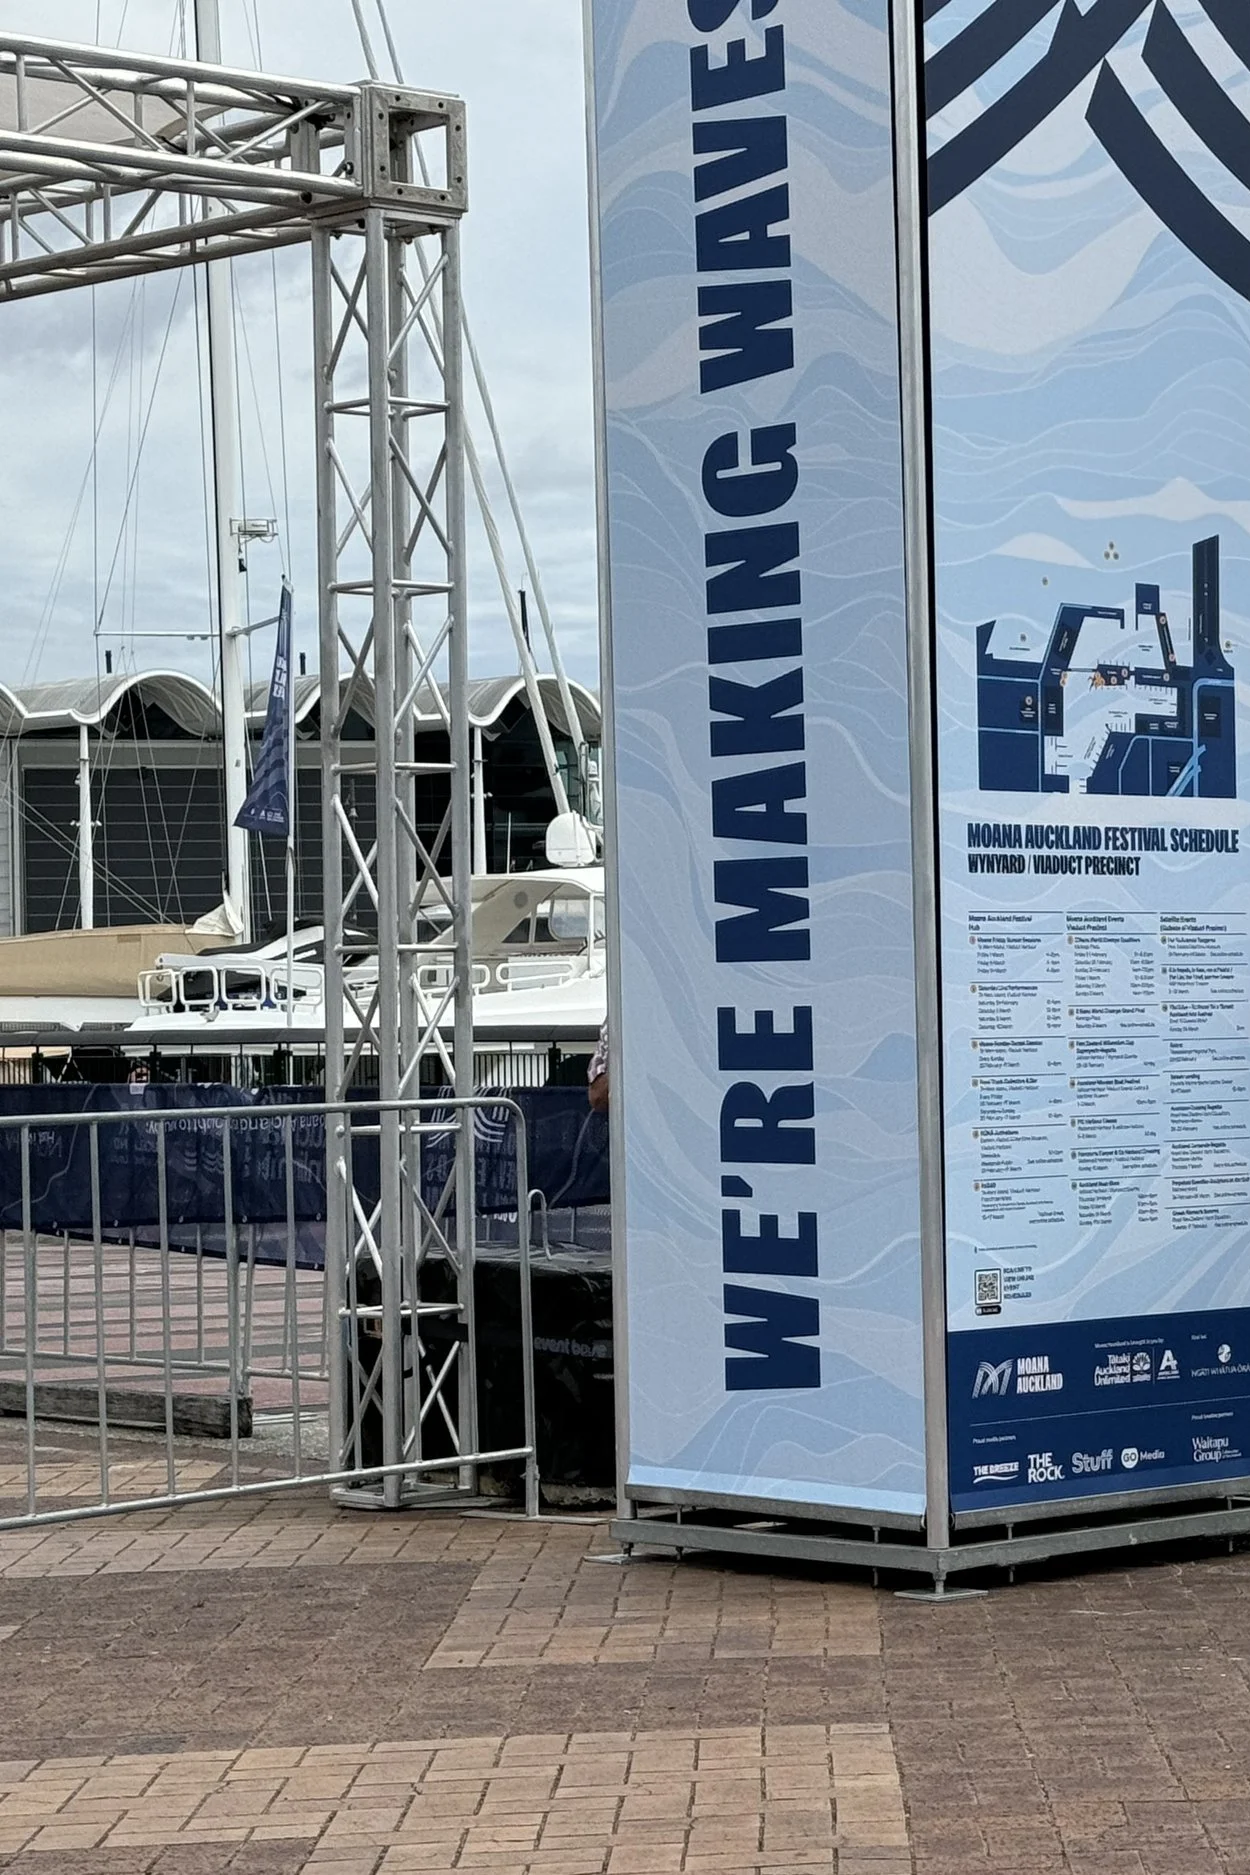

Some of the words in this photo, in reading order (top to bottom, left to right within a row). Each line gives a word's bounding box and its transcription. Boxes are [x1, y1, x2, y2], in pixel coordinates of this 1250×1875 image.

[702, 422, 810, 962] MAKING
[968, 823, 1022, 849] MOANA
[1025, 824, 1101, 850] AUCKLAND
[1104, 827, 1168, 852] FESTIVAL
[1170, 828, 1239, 853] SCHEDULE
[968, 854, 1026, 874] WYNYARD
[1033, 855, 1083, 875] VIADUCT
[1085, 856, 1141, 876] PRECINCT
[718, 1006, 820, 1391] WE'RE
[1017, 1356, 1049, 1375] MOANA
[1095, 1364, 1131, 1376] Auckland
[1016, 1373, 1063, 1394] AUCKLAND
[1094, 1373, 1131, 1386] Unlimited
[1192, 1436, 1229, 1450] Waitapu
[1028, 1452, 1053, 1469] THE
[1072, 1449, 1113, 1474] Stuff
[1122, 1452, 1138, 1462] GO
[1140, 1449, 1165, 1461] Media
[1193, 1450, 1222, 1463] Group
[973, 1465, 989, 1476] THE
[989, 1461, 1019, 1475] BREEZE
